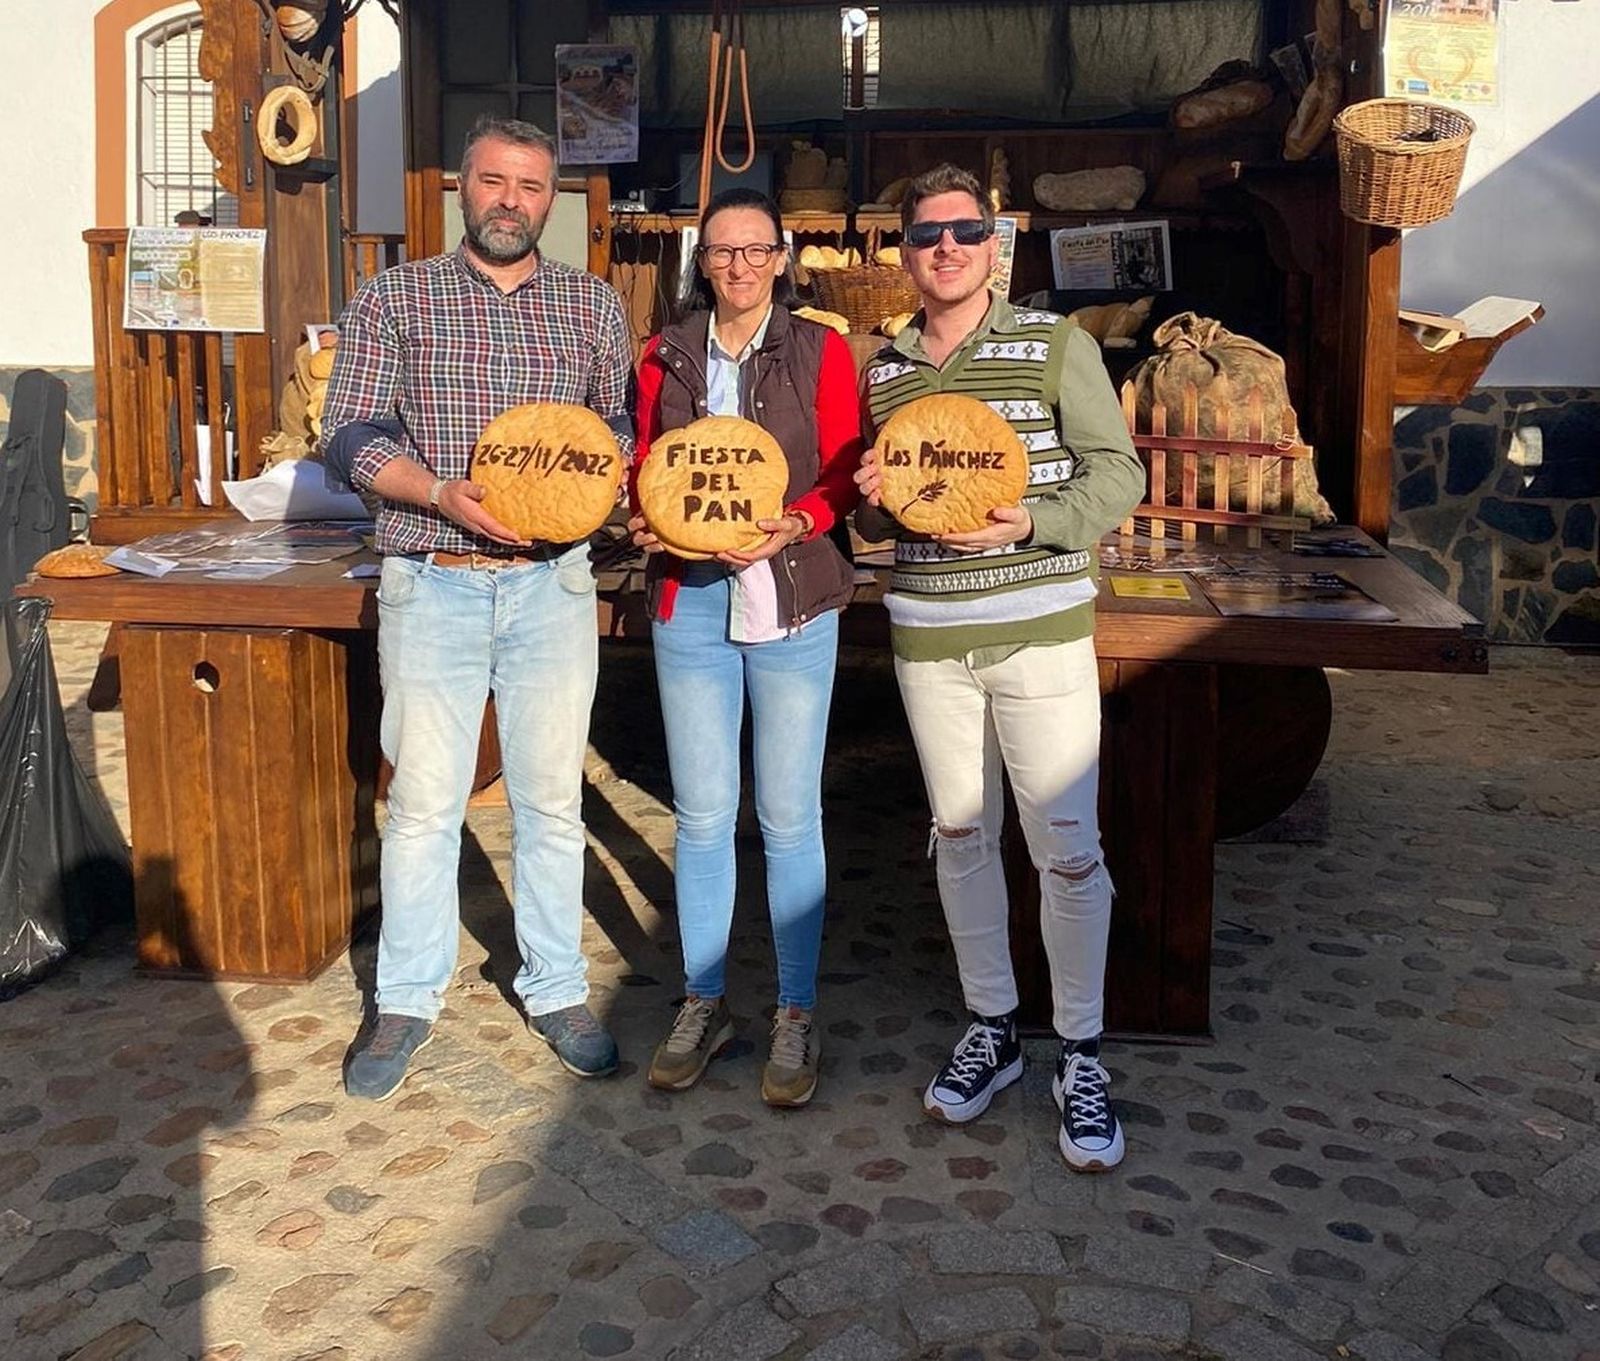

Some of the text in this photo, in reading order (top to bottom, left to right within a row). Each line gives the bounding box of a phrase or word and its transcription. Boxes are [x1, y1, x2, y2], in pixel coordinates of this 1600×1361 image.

[476, 439, 614, 478] 26-27/11/2022
[691, 471, 740, 491] DEL
[683, 495, 752, 522] PAN
